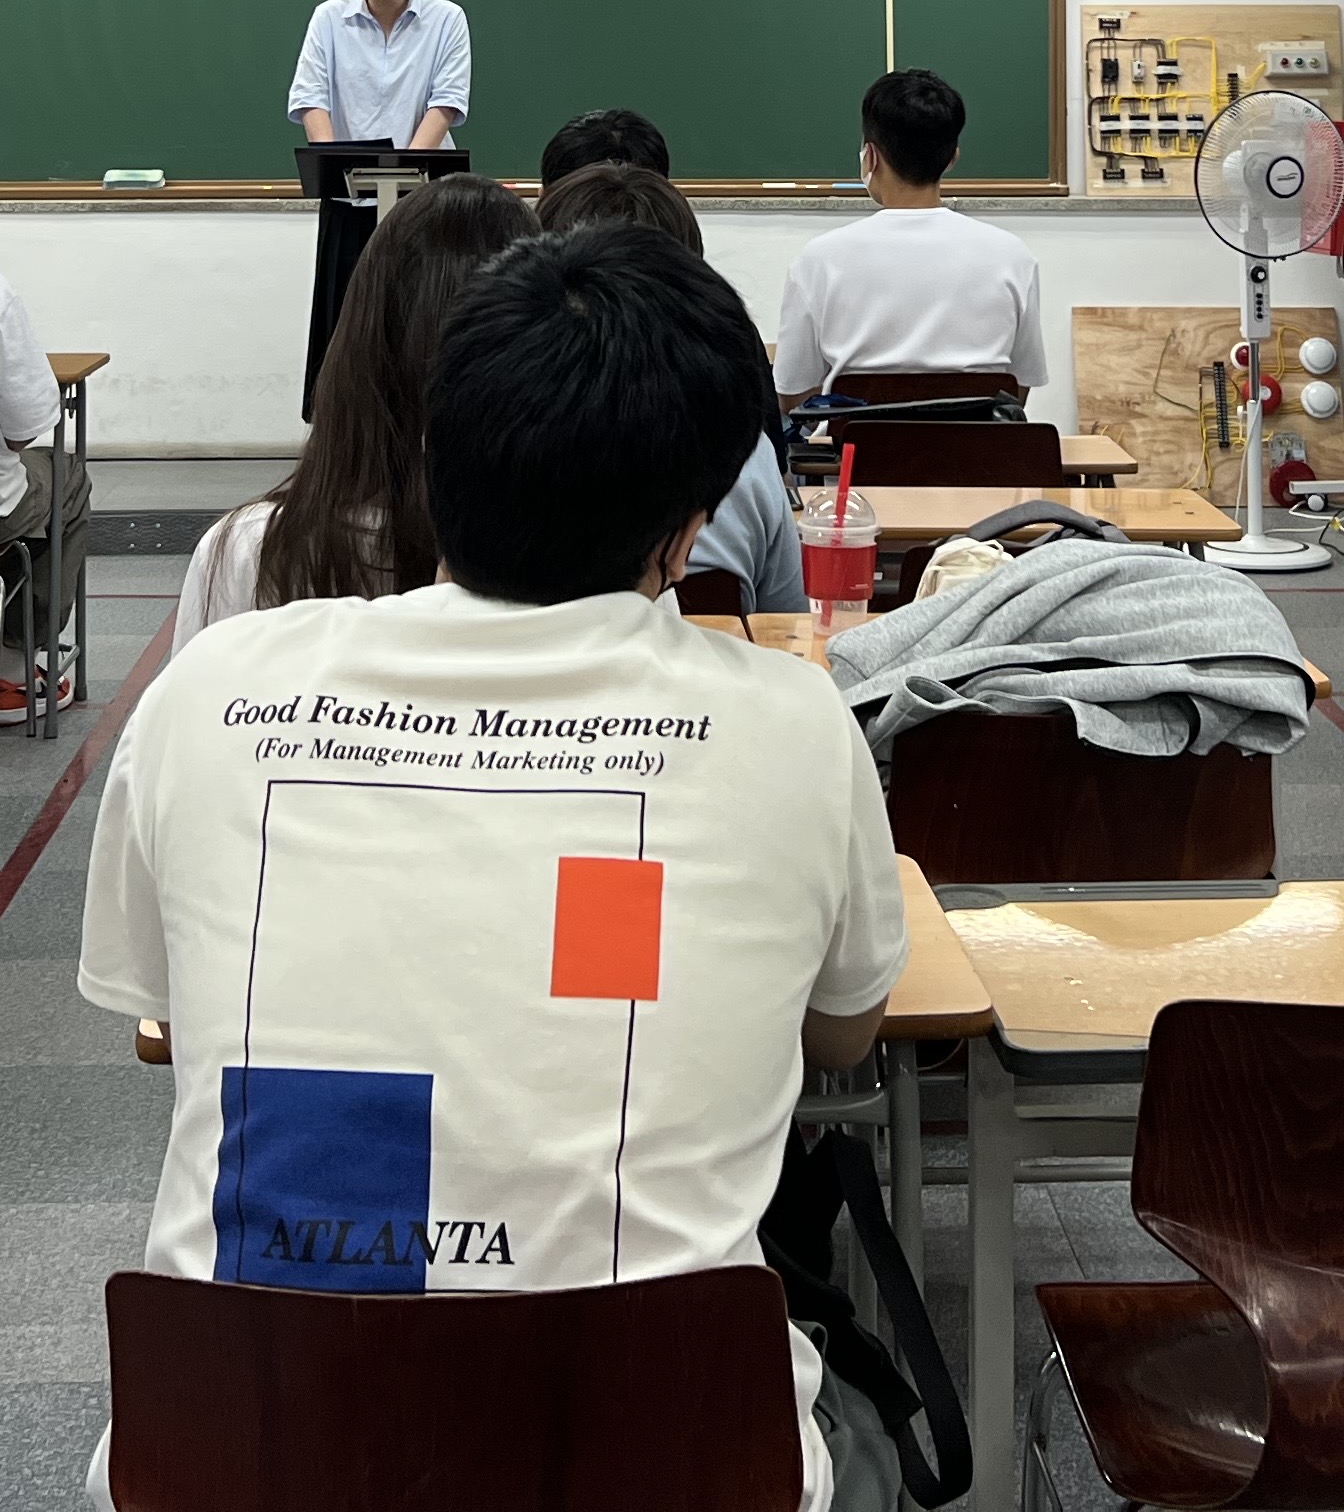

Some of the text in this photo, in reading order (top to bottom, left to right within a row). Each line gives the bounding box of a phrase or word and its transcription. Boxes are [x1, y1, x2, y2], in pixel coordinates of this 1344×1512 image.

[223, 694, 713, 745] Good Fashion Management
[255, 737, 666, 778] (For Management Marketing only)
[262, 1217, 516, 1266] ATLANTA
